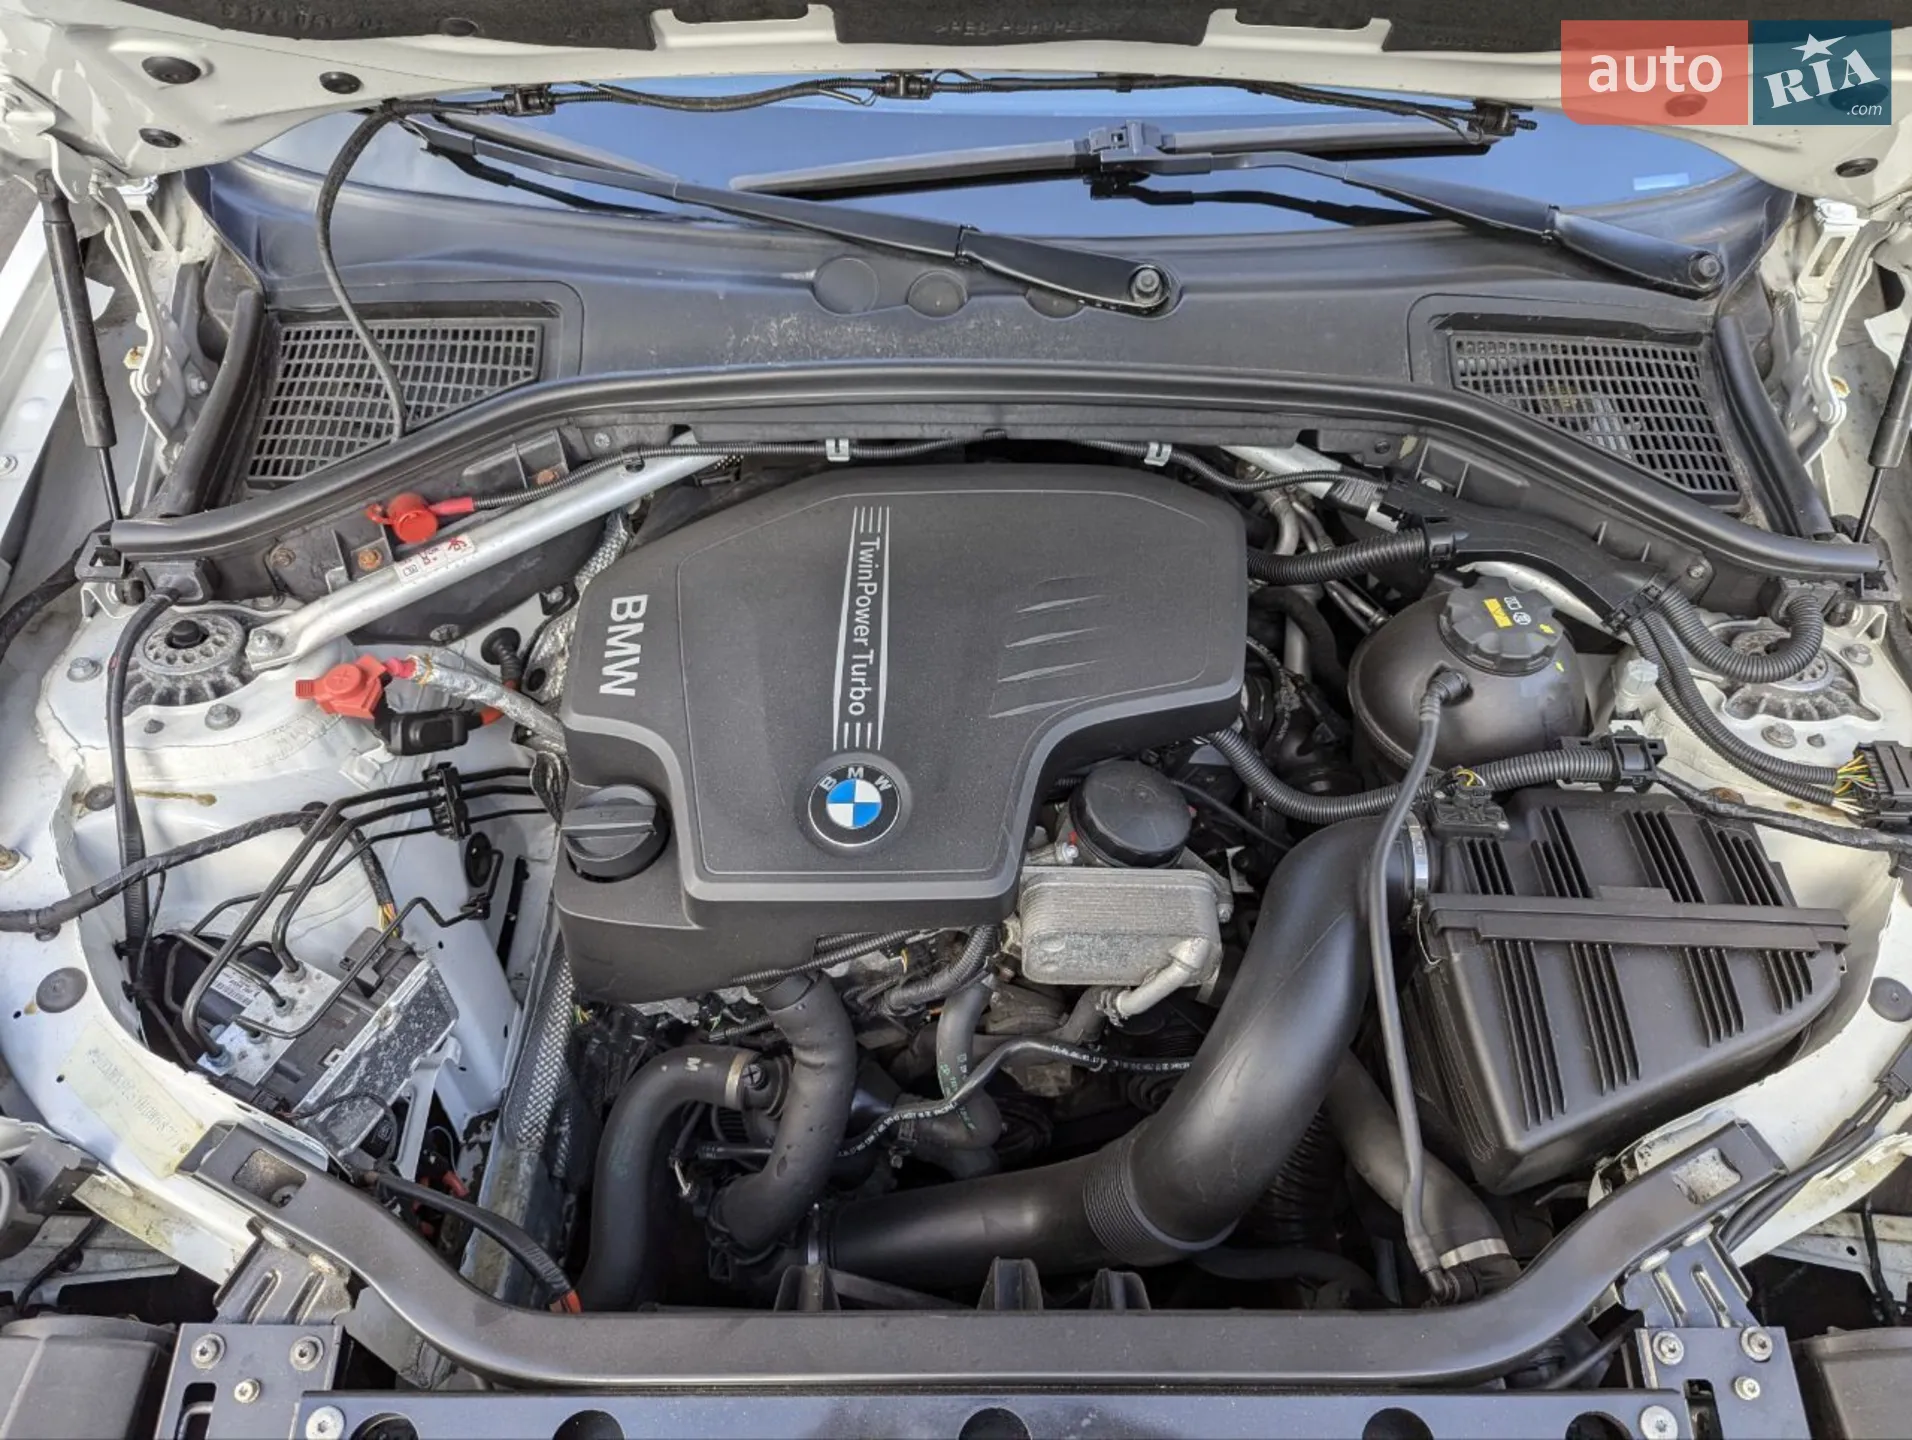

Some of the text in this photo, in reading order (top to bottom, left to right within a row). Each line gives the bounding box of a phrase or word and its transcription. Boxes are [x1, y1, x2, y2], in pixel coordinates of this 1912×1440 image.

[599, 594, 649, 696] BMW
[848, 536, 880, 716] TwinPower Turbo
[819, 766, 892, 791] BMW
